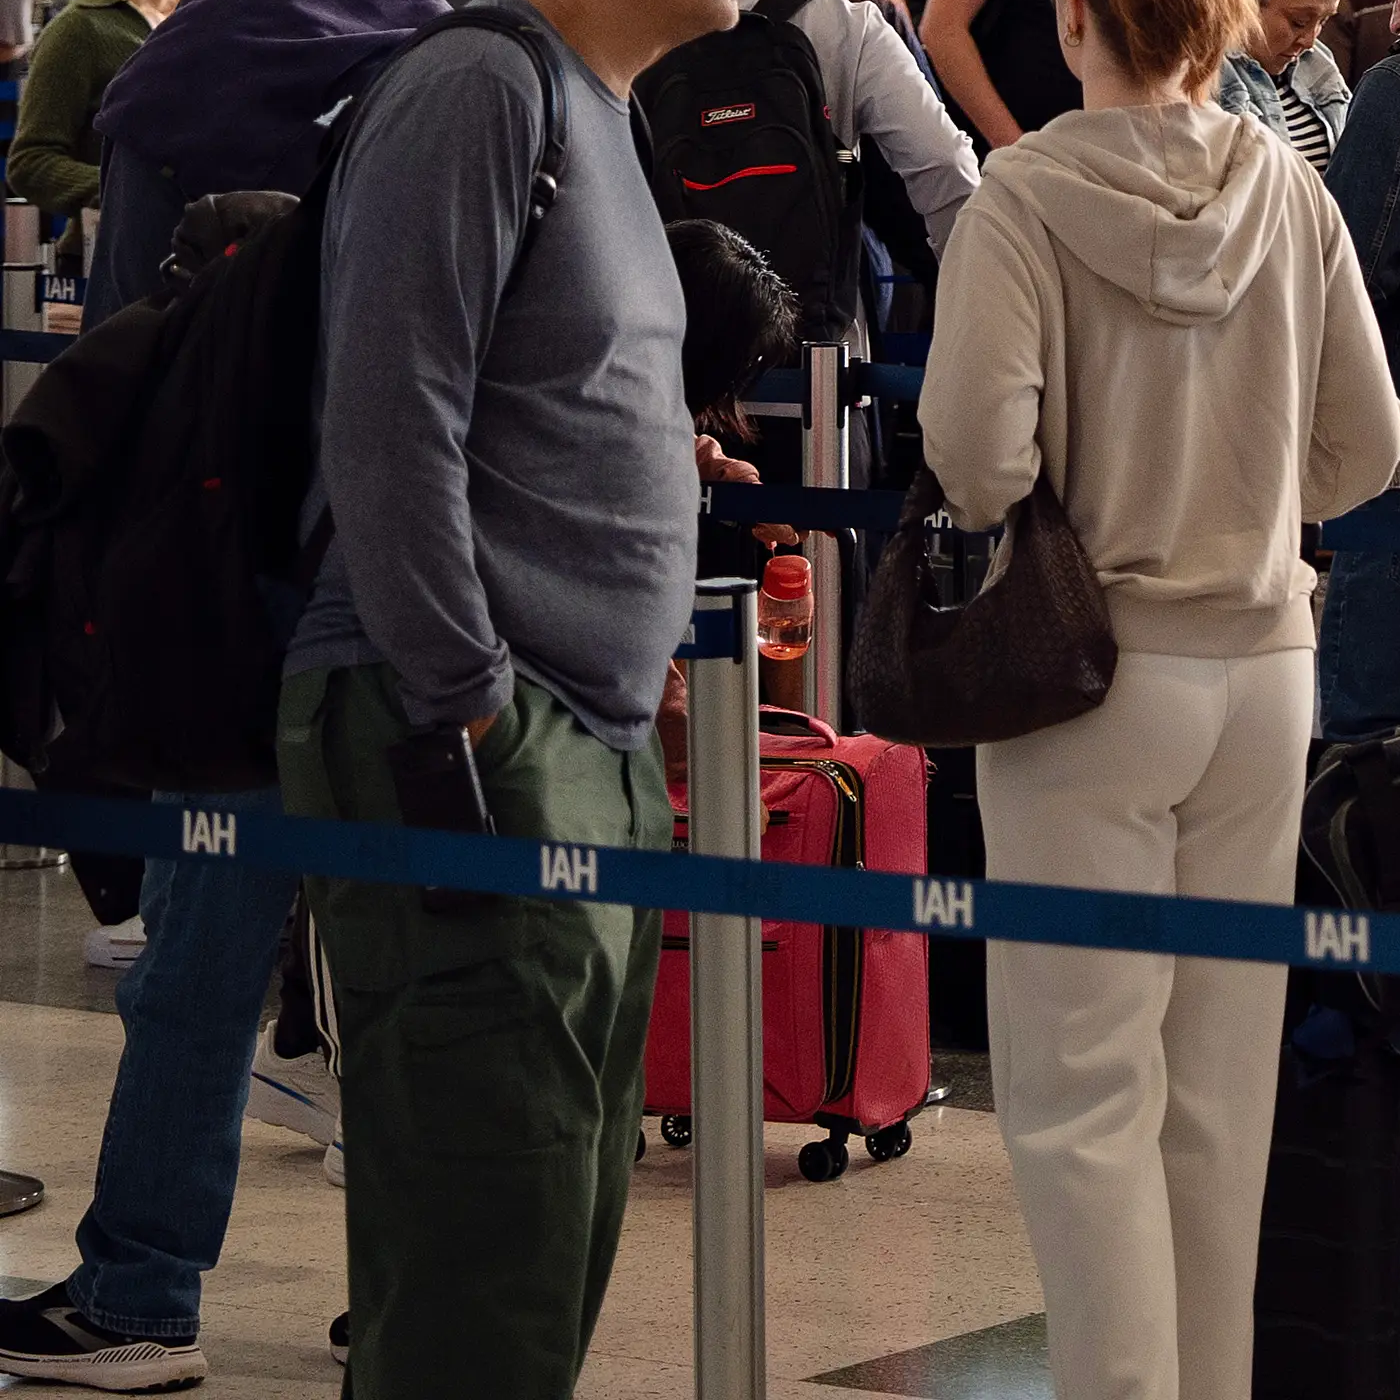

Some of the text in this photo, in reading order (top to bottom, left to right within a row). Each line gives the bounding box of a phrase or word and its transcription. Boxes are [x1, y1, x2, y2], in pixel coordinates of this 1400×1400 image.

[45, 277, 75, 301] IAH
[183, 810, 236, 855] IAH
[541, 845, 597, 892] IAH
[914, 880, 973, 928] IAH
[1305, 912, 1370, 963] IAH
